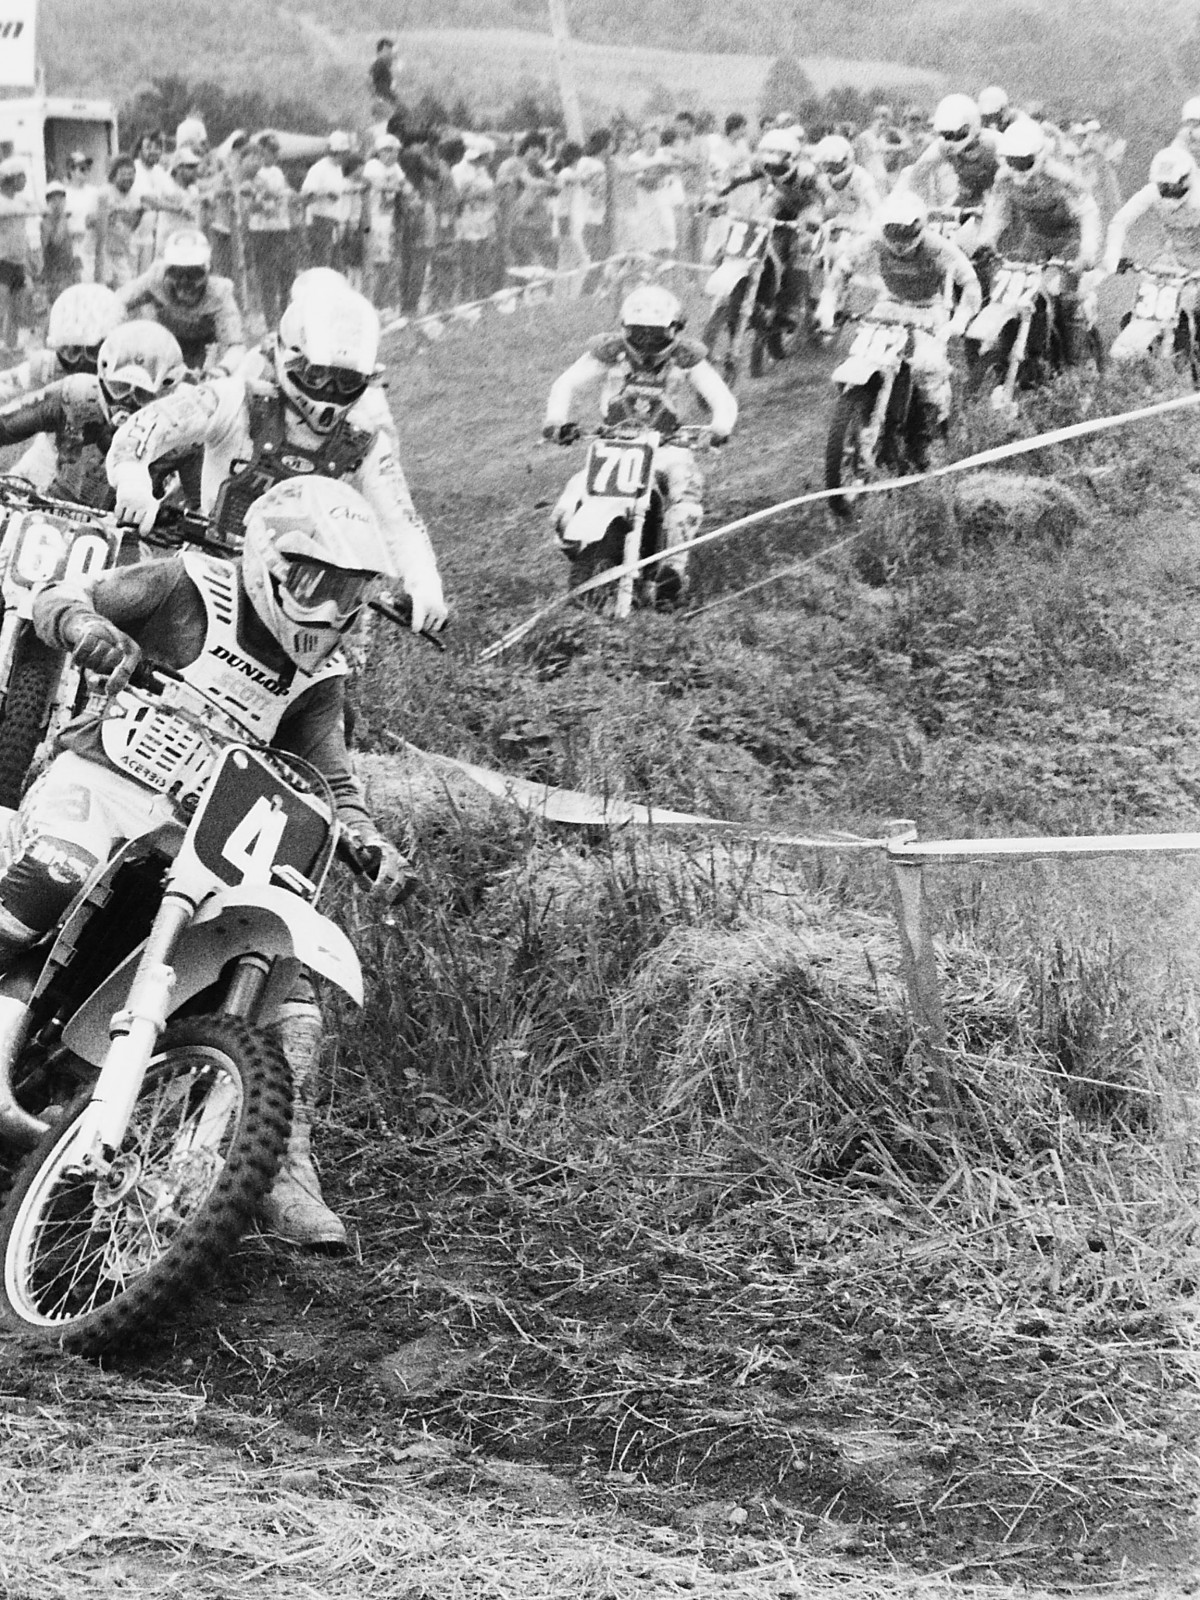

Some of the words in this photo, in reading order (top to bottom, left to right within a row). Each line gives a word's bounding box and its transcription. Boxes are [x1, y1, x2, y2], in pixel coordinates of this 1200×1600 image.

[593, 447, 645, 494] 70
[17, 523, 109, 582] 60
[209, 645, 290, 697] DUNLOP
[221, 796, 288, 885] 4
